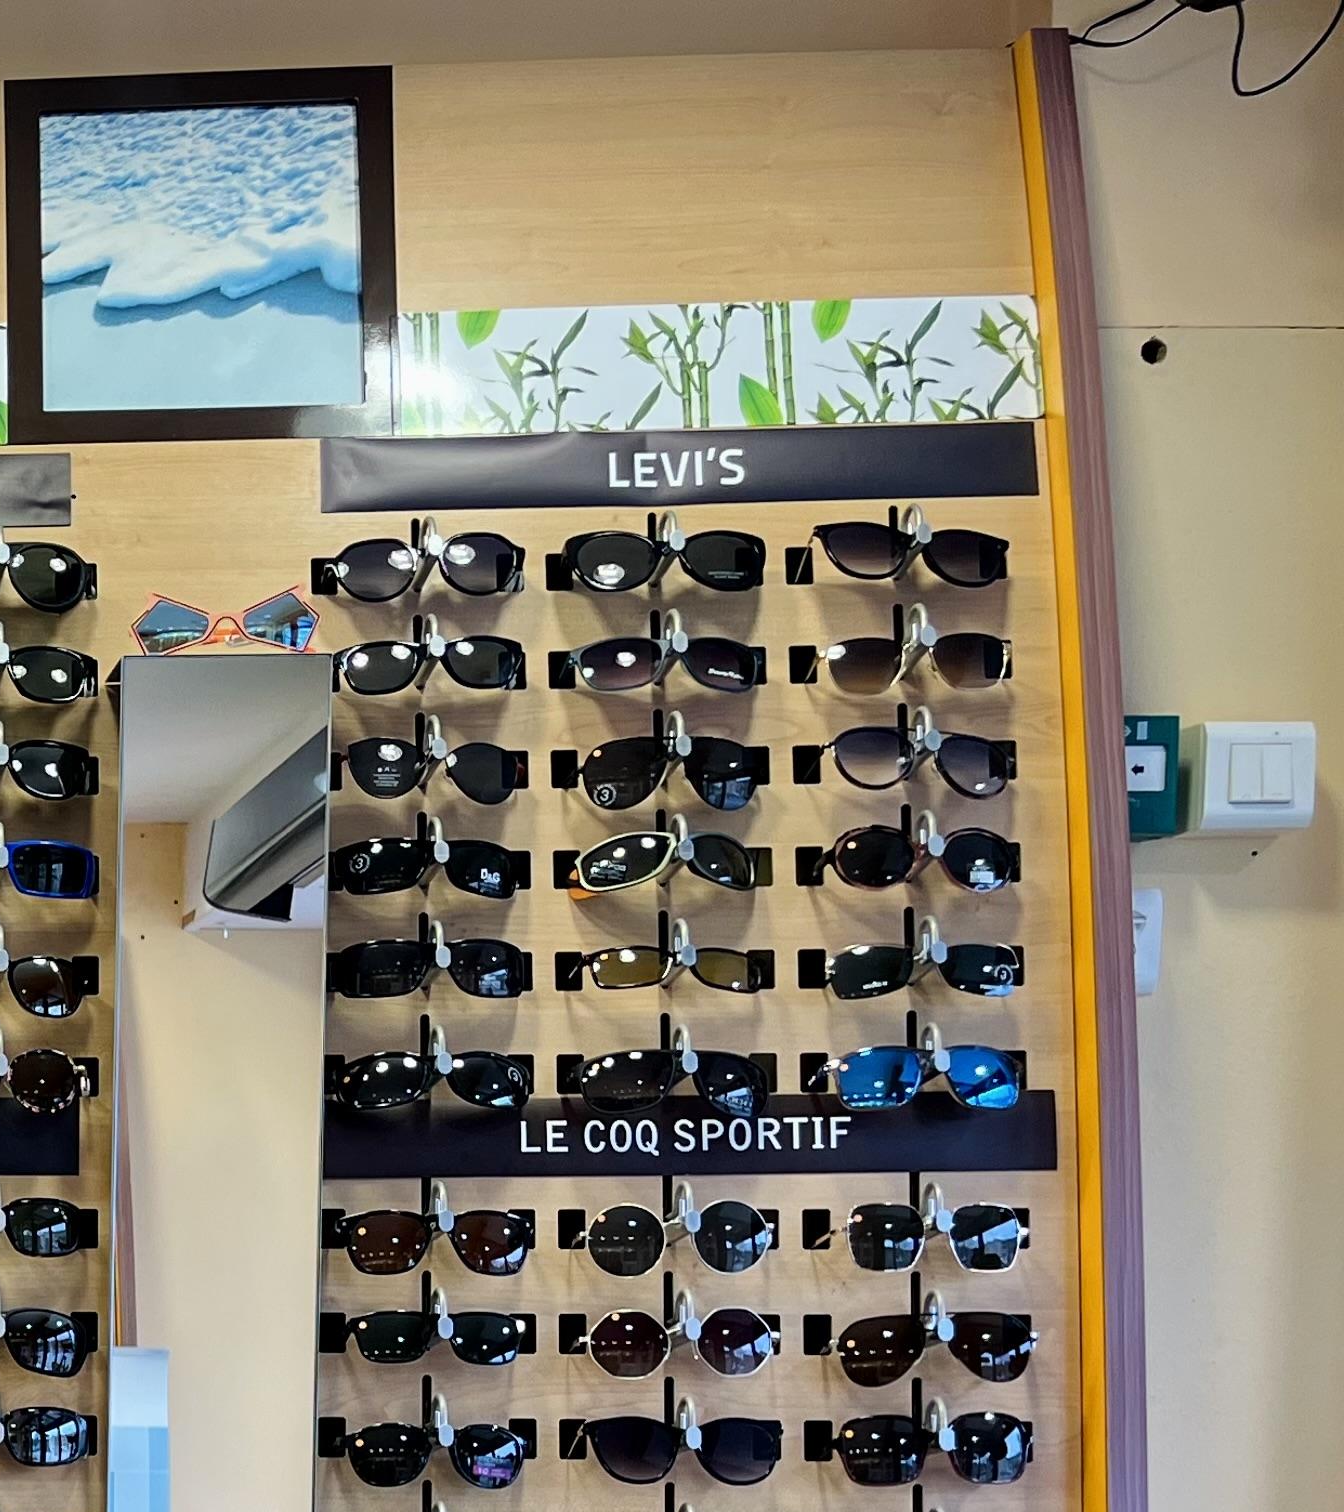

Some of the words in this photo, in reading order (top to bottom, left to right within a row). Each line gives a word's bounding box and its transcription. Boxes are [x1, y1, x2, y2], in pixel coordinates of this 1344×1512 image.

[607, 447, 746, 489] LEVI'S
[519, 1119, 570, 1153] LE
[584, 1118, 660, 1157] COQ
[673, 1115, 852, 1152] SPORTIF
